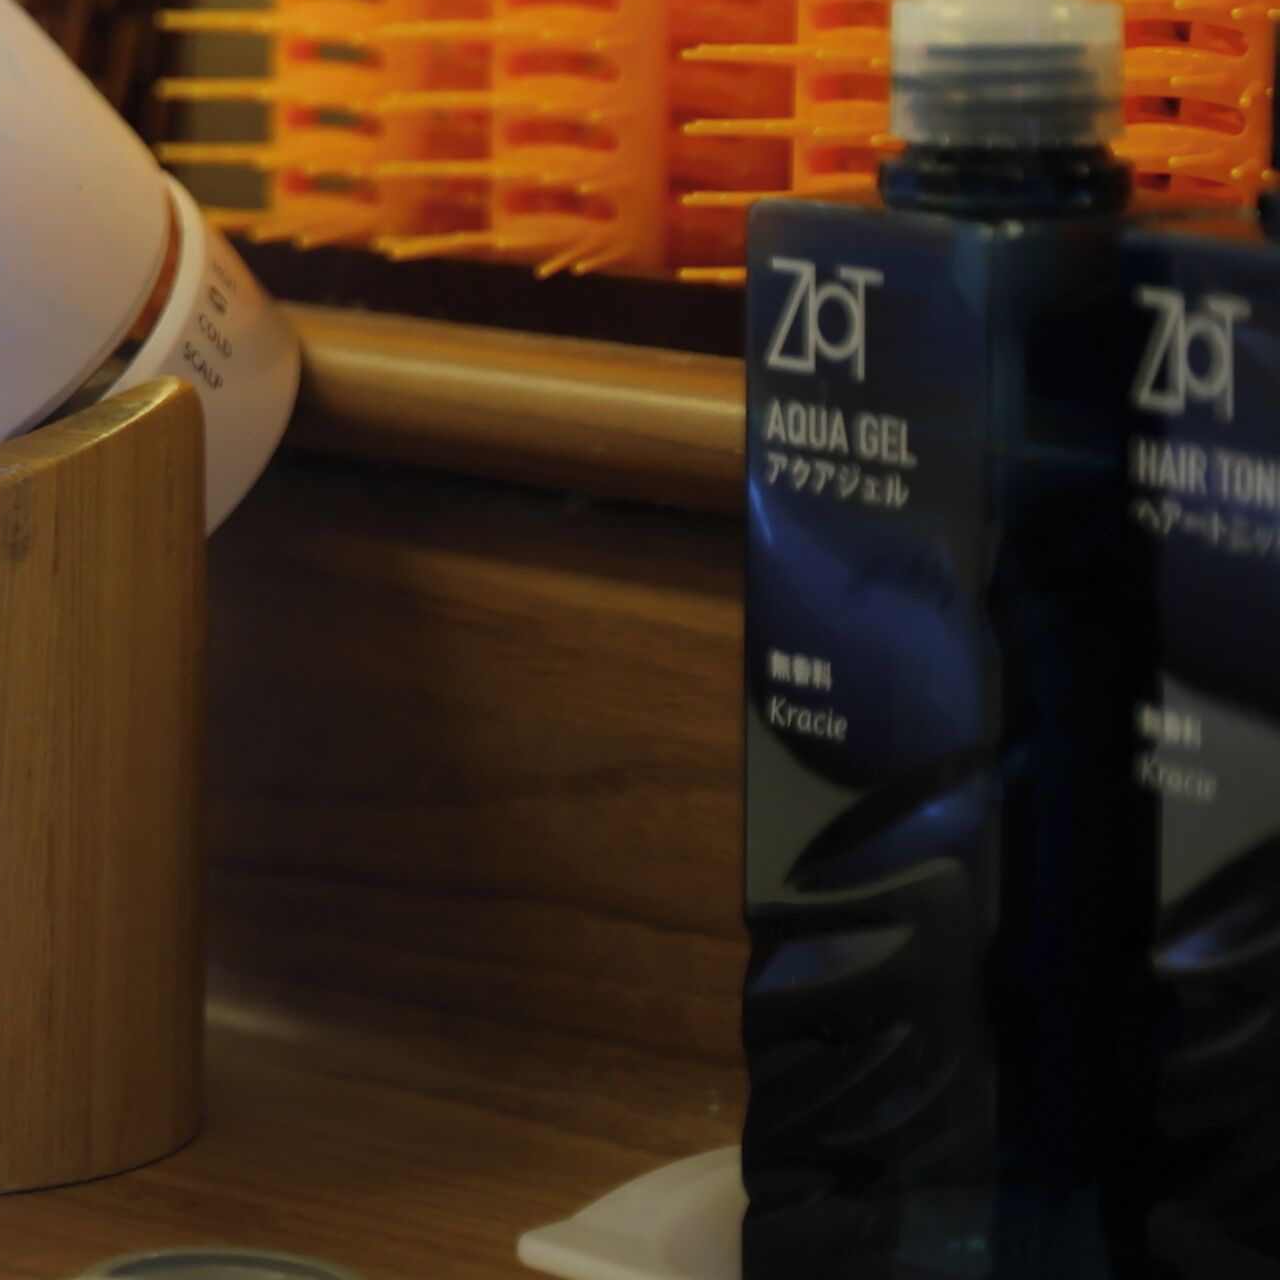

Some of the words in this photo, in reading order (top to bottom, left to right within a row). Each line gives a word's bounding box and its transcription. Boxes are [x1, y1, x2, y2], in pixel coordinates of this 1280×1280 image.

[183, 341, 223, 390] SCALP
[199, 313, 232, 359] COLD
[765, 399, 850, 456] AQUA
[857, 413, 918, 468] GEL
[766, 451, 909, 510] アクアジェル
[1134, 437, 1207, 497] HAIR
[1134, 497, 1280, 558] ヘアートニッ
[768, 694, 848, 742] Kracie
